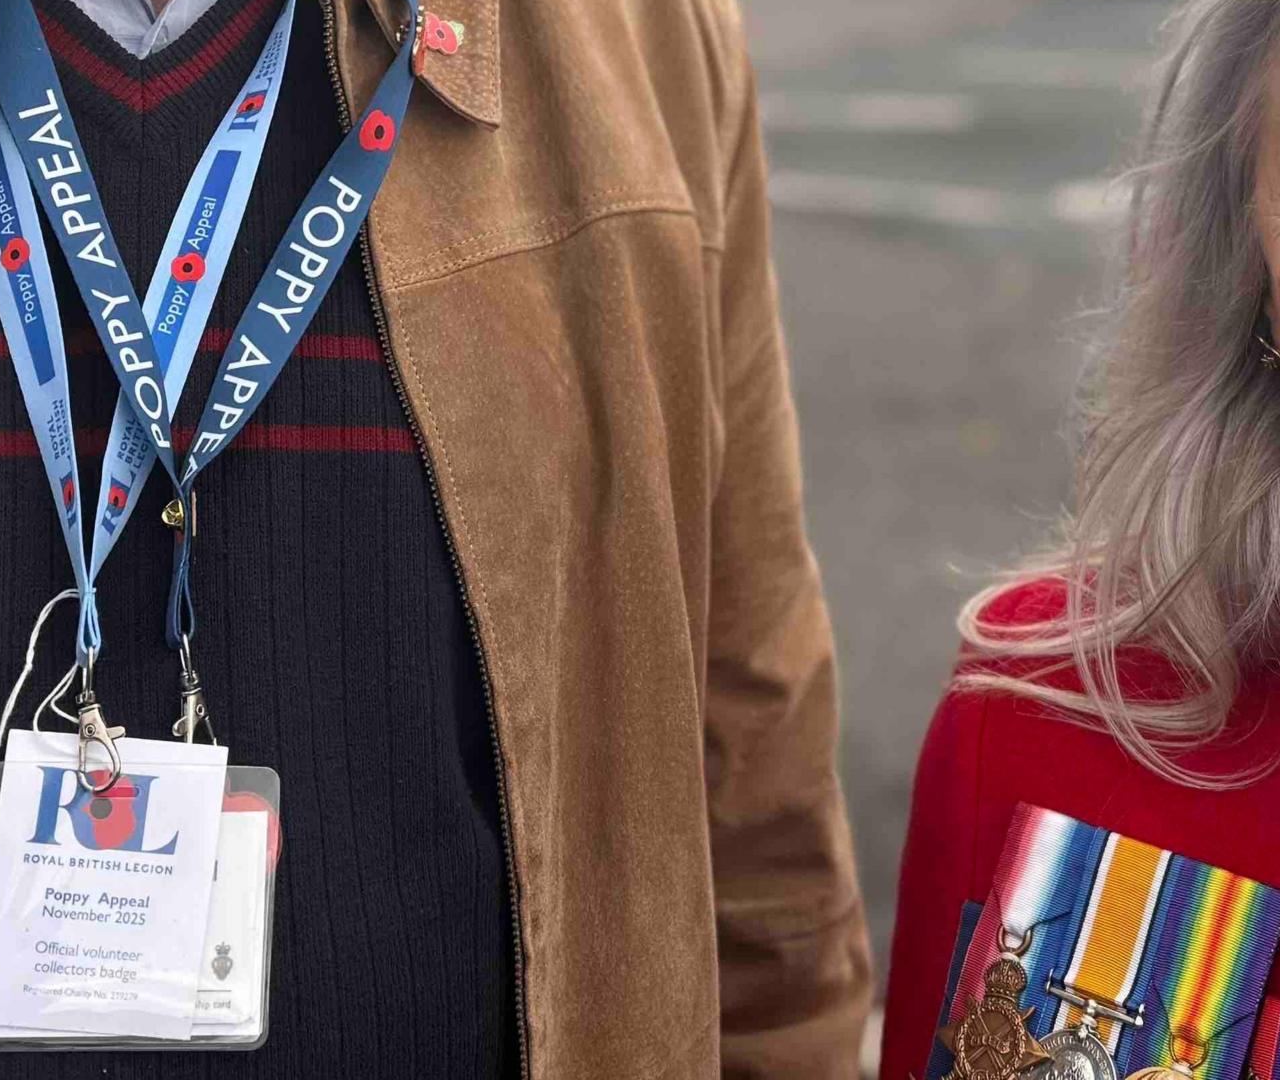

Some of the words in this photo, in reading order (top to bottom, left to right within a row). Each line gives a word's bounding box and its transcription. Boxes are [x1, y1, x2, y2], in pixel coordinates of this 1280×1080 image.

[18, 89, 117, 268] APPEAL
[158, 285, 190, 335] Poppy
[188, 196, 217, 250] Appeal
[257, 175, 363, 334] POPPY
[18, 273, 38, 324] Poppy
[91, 289, 171, 448] POPPY
[47, 416, 60, 460] ROYAL
[117, 418, 136, 460] ROYAL
[23, 853, 64, 867] ROYAL
[69, 857, 121, 871] BRITISH
[125, 863, 174, 876] LEGION
[42, 905, 111, 923] November
[115, 911, 146, 926] 2025
[45, 887, 90, 906] Poppy
[98, 892, 151, 909] Appeal
[34, 961, 96, 977] collectors
[99, 965, 137, 983] badge
[35, 940, 79, 957] Official
[82, 945, 143, 962] volunteer
